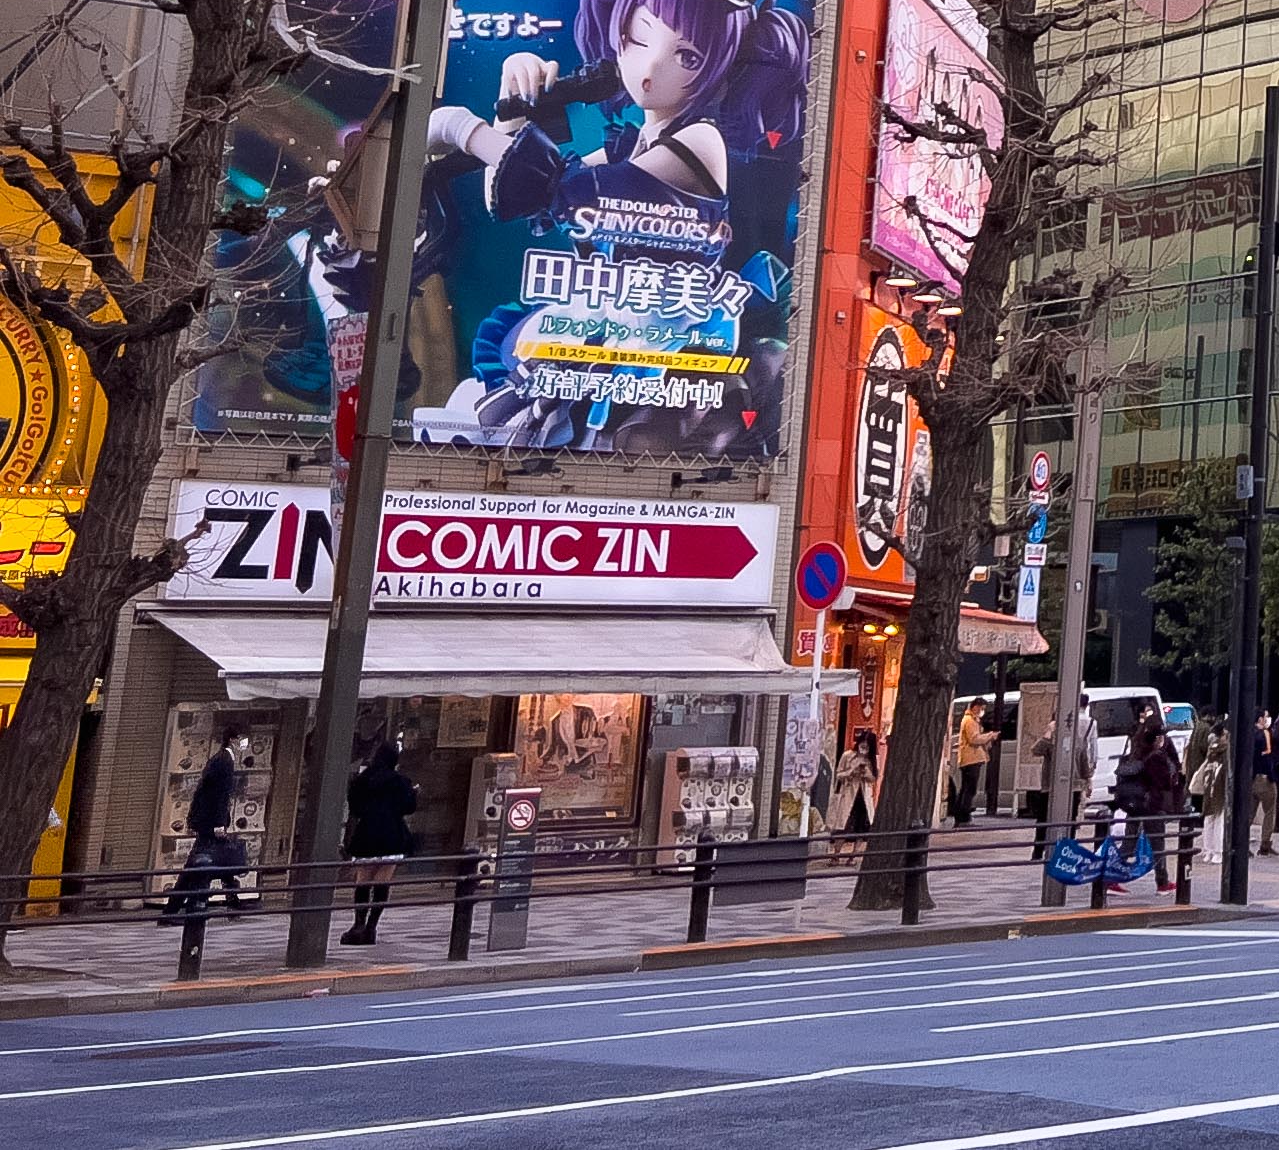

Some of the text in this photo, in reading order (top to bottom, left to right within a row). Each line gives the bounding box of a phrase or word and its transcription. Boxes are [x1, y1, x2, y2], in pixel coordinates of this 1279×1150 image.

[569, 207, 709, 242] SHINY COLORS
[525, 252, 751, 318] 田中摩美々
[548, 346, 567, 357] 1/8
[568, 348, 606, 361] スケール
[706, 336, 729, 349] ver.
[531, 369, 725, 410] 好評予約受付中!
[205, 489, 280, 509] COMIC
[384, 494, 736, 520] Professional Support for Magazine & MANGA-ZIN
[386, 520, 670, 573] COMIC ZIN
[374, 575, 542, 599] Akihabara
